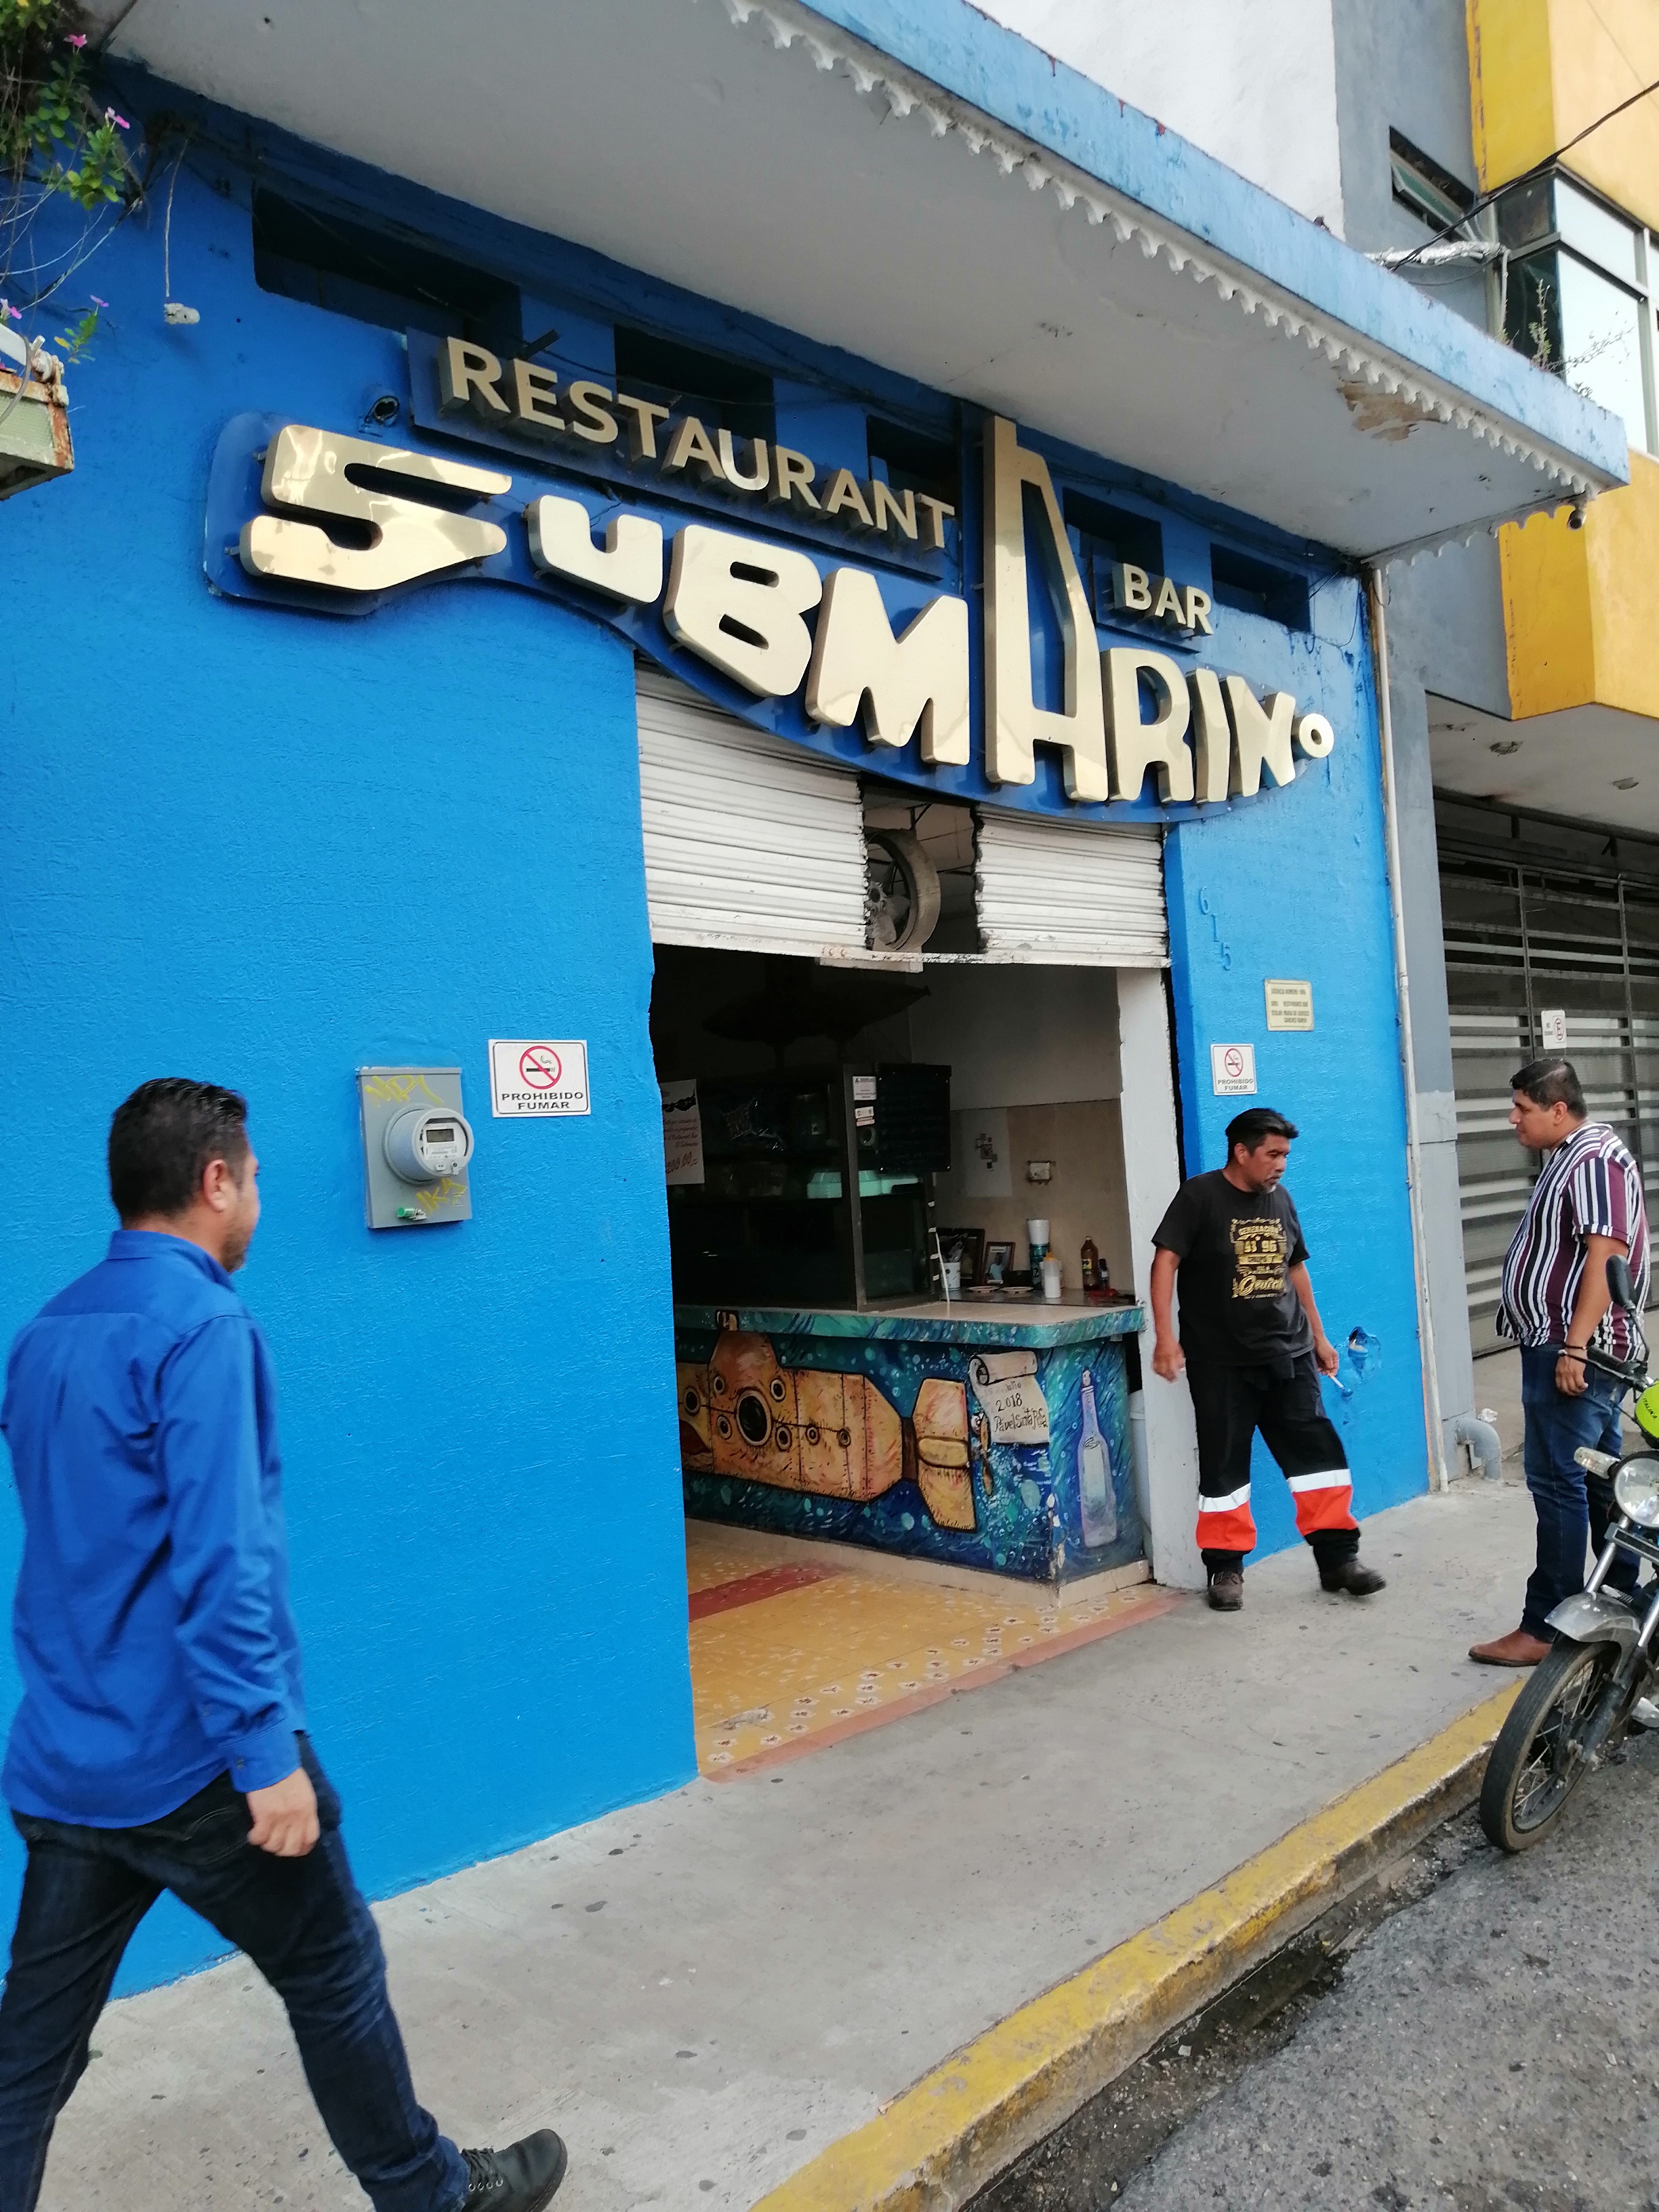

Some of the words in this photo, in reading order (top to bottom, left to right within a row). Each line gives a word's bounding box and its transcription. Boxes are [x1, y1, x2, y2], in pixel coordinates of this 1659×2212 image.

[437, 335, 954, 551] RESTAURANT
[1113, 562, 1213, 636] BAR
[501, 1092, 583, 1101] PROHIBIDO
[518, 1101, 570, 1110] FUMAR
